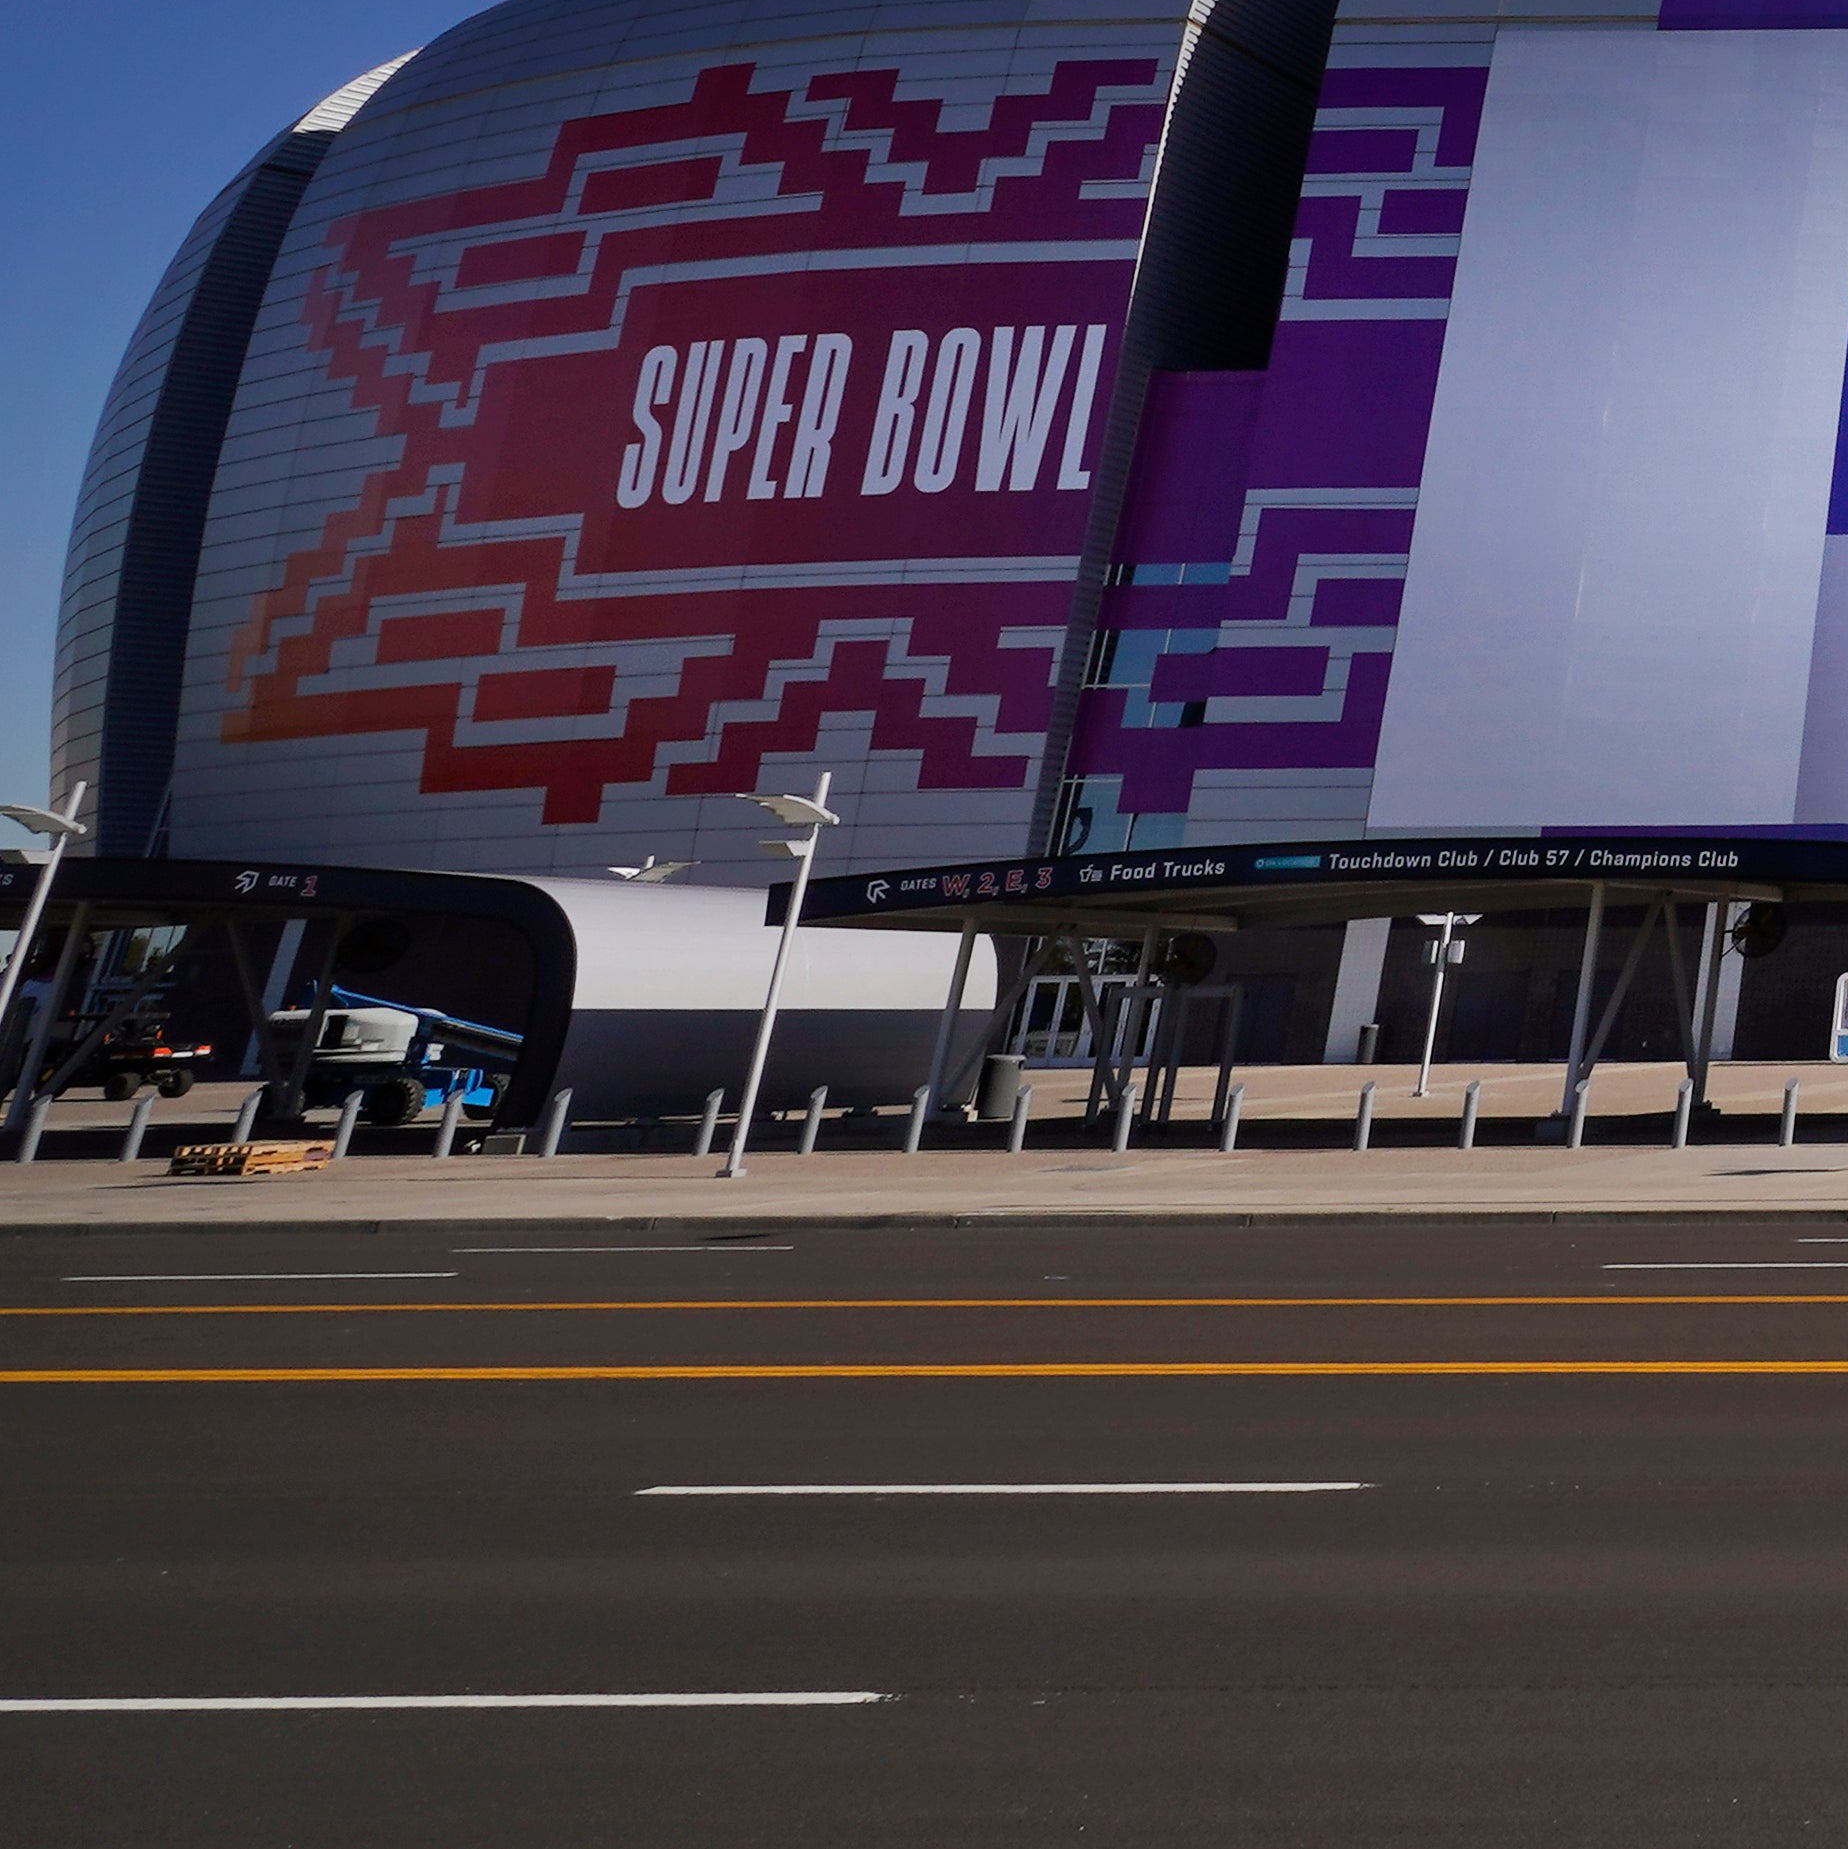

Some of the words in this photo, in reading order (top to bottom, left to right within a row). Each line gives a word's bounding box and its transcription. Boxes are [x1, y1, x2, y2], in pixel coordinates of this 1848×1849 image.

[616, 332, 853, 509] SUPER
[860, 323, 1107, 496] BOWL
[1110, 861, 1157, 881] Food
[1163, 858, 1226, 878] Trucks
[1328, 851, 1431, 870] Touchdown
[1437, 850, 1478, 868] Club
[1498, 849, 1539, 867] Club
[1545, 849, 1570, 866] 57
[1589, 849, 1692, 870] Champions
[1698, 850, 1739, 868] Club
[268, 875, 297, 888] GATE
[300, 874, 318, 897] 1
[900, 878, 937, 891] GATES
[1035, 867, 1053, 889] 3
